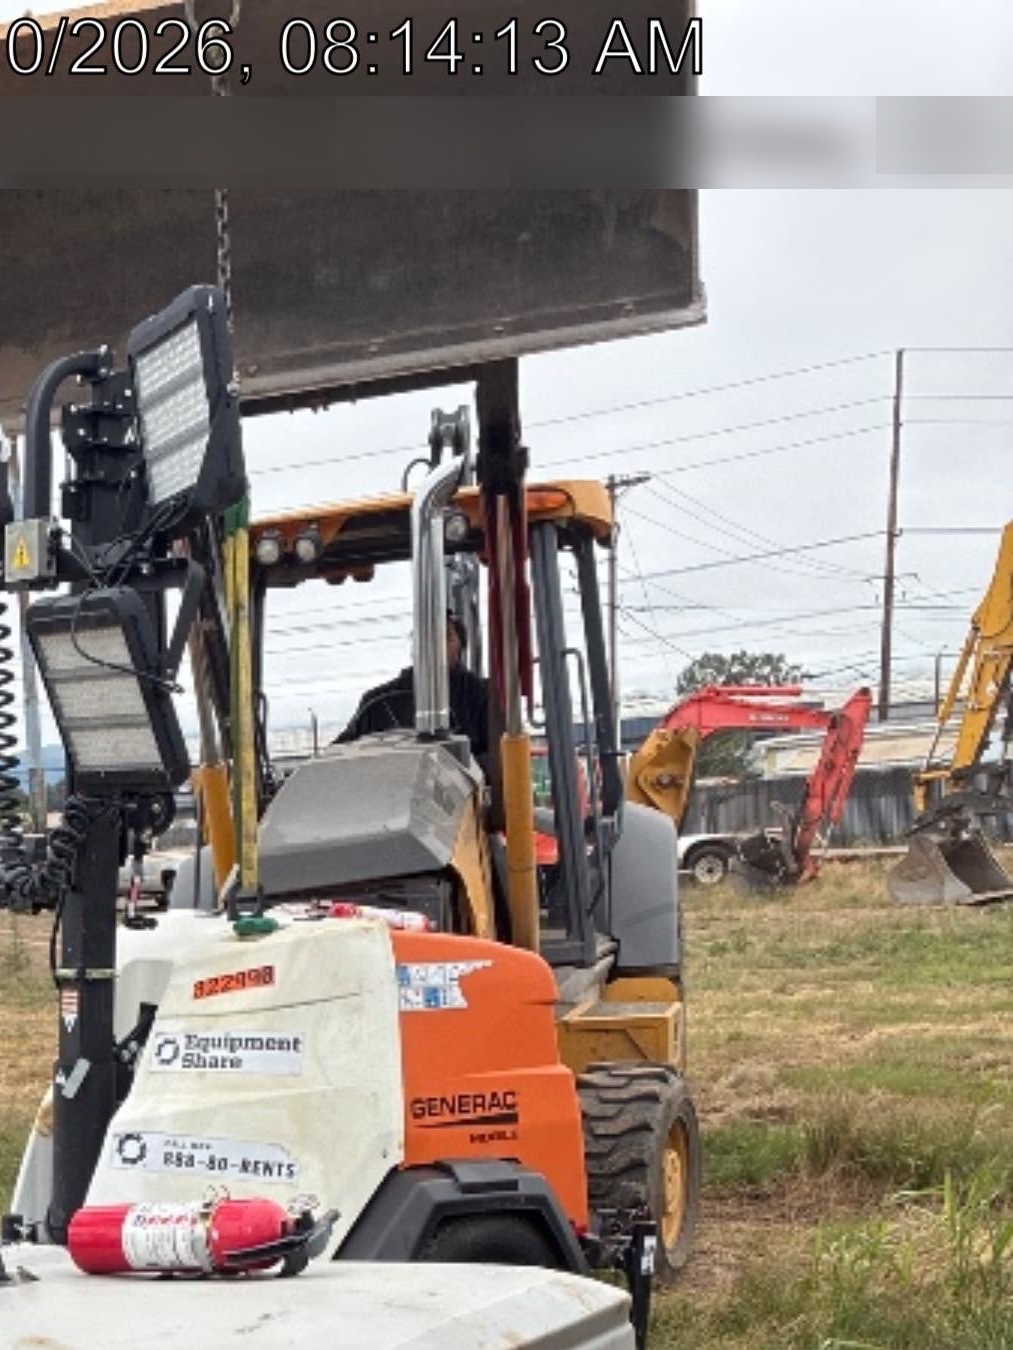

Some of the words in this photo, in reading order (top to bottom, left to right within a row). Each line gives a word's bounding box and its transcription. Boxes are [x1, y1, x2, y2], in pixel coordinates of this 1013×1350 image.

[184, 1033, 302, 1053] Equipment
[181, 1053, 243, 1069] Share
[410, 1091, 517, 1119] GENERAC
